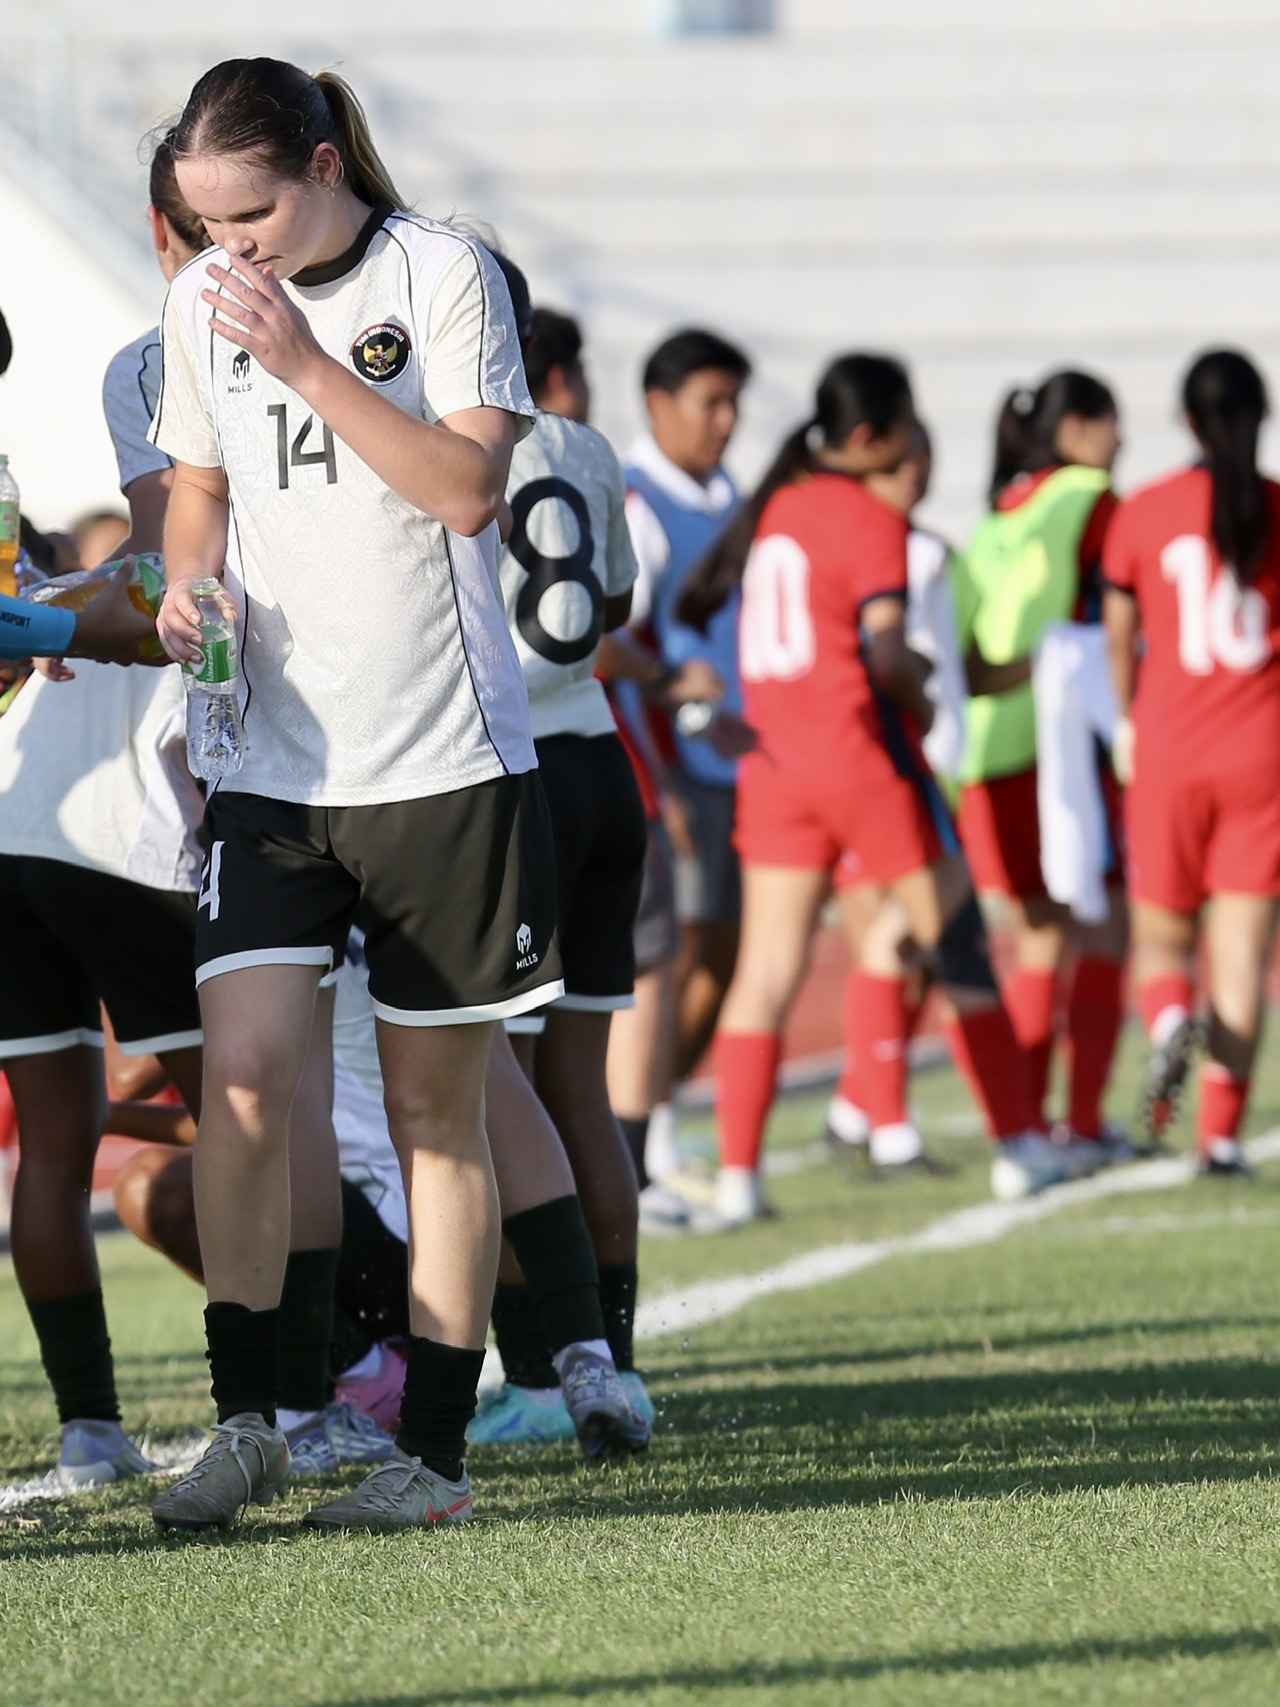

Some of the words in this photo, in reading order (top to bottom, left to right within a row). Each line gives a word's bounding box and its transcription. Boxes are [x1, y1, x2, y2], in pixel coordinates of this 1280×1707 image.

[355, 333, 369, 348] TIM
[368, 326, 405, 343] INDONESIA
[227, 383, 252, 394] MILLS
[267, 403, 338, 490] 14
[508, 475, 605, 665] 8
[1159, 533, 1272, 677] 16
[516, 953, 539, 970] MILLS
